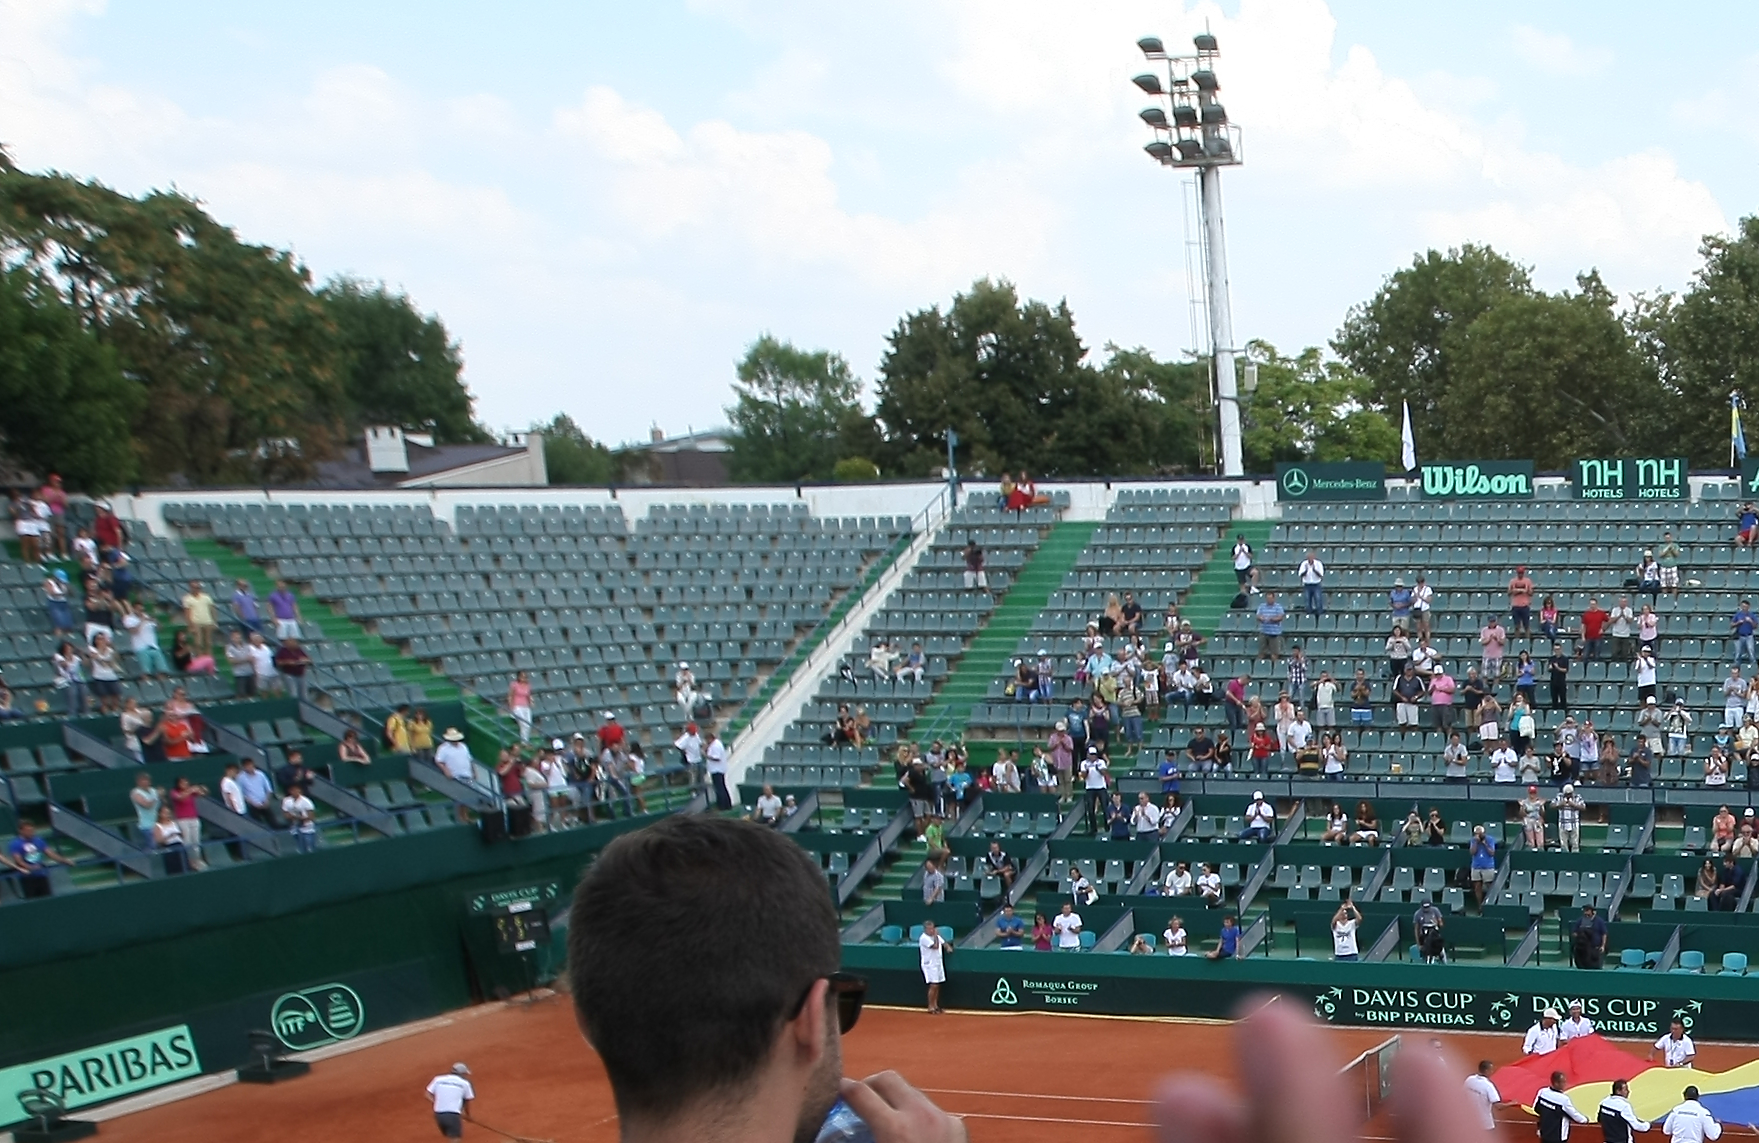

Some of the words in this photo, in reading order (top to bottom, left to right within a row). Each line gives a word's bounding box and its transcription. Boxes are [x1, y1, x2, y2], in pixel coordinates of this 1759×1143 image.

[1312, 478, 1377, 489] Mercedes-Benz
[1582, 488, 1624, 499] HOTELS
[1638, 488, 1680, 498] HOTELS
[1353, 989, 1419, 1008] DAVIS
[1425, 991, 1474, 1010] CUP
[1606, 998, 1657, 1017] CUP
[1366, 1010, 1400, 1022] BNP
[1404, 1012, 1475, 1025] PARIBAS
[32, 1034, 194, 1101] PARIBAS
